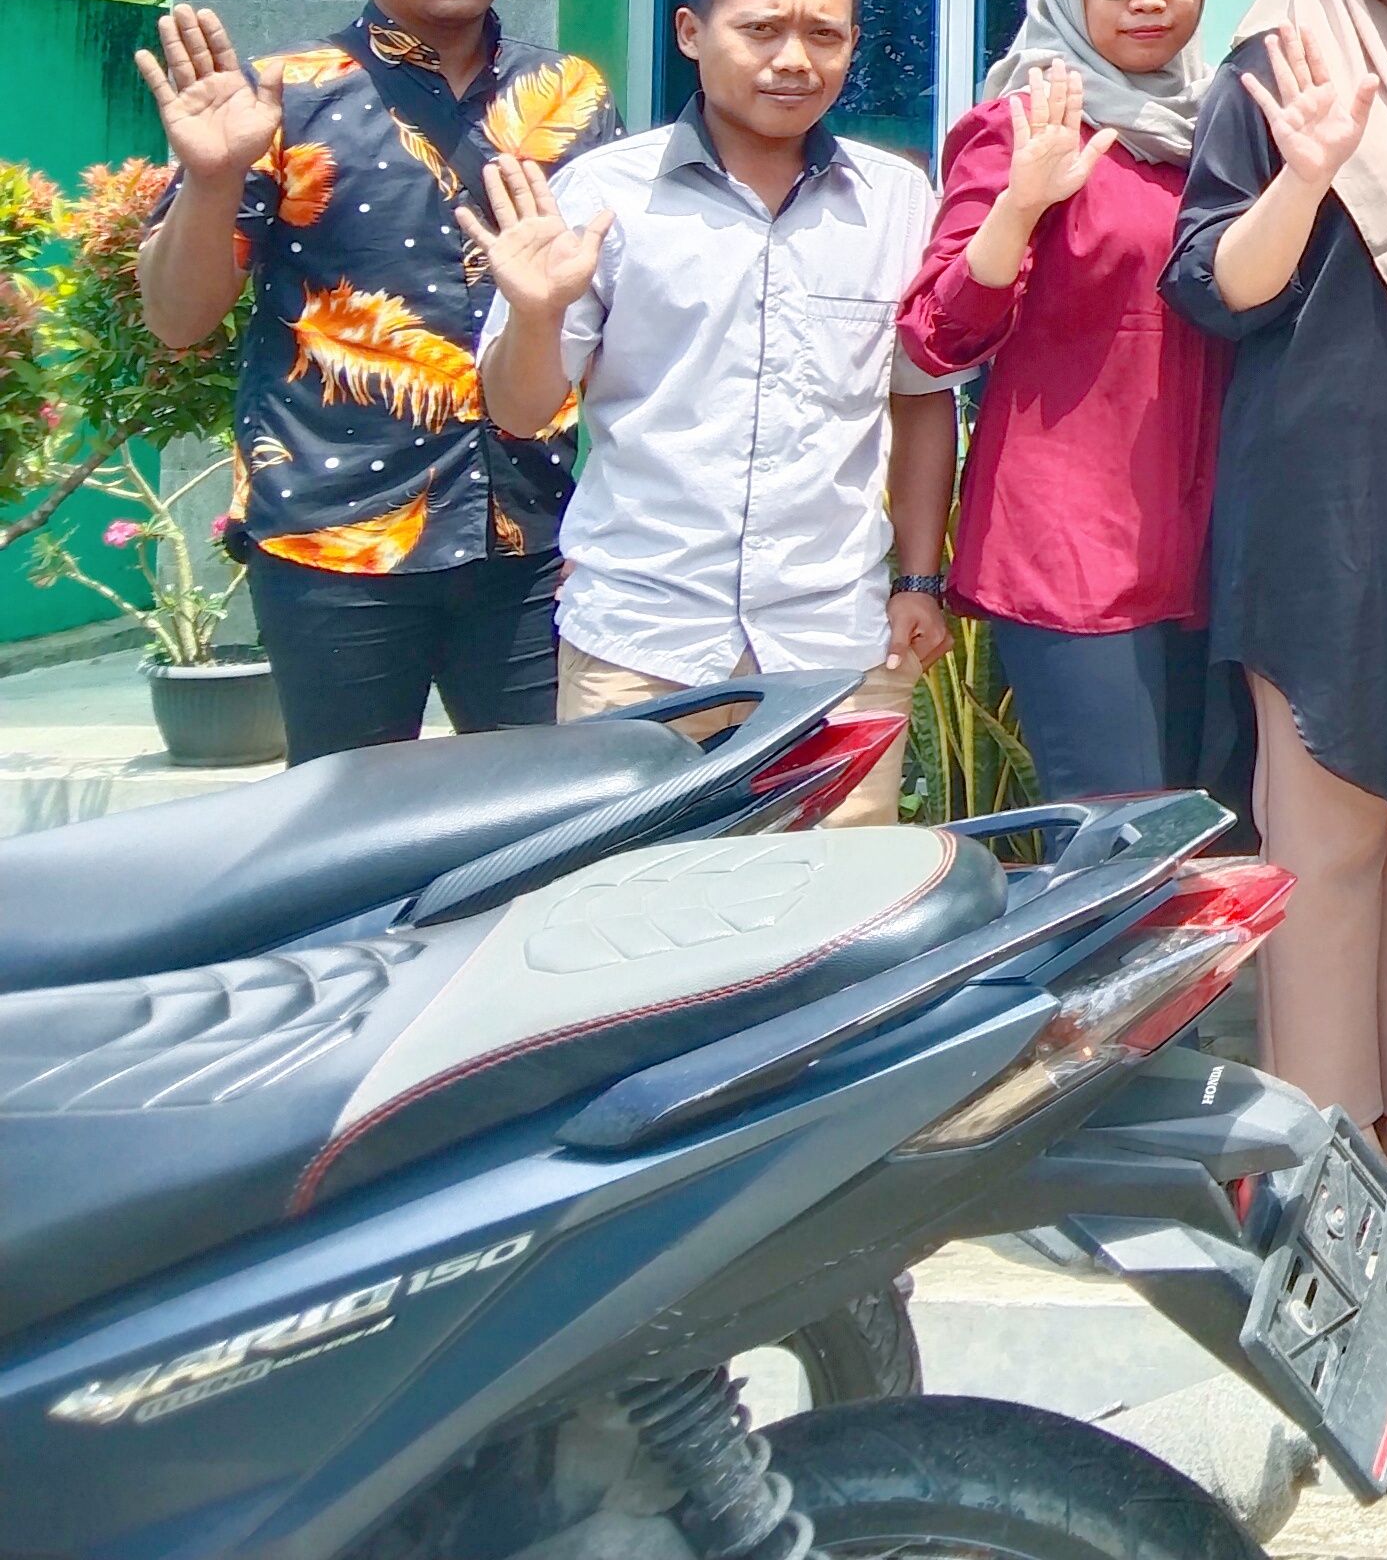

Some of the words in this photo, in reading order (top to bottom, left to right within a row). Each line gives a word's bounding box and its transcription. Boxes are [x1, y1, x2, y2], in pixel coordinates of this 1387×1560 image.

[1201, 1065, 1225, 1105] HONDA
[48, 1276, 402, 1425] VARIO
[407, 1230, 535, 1297] 150
